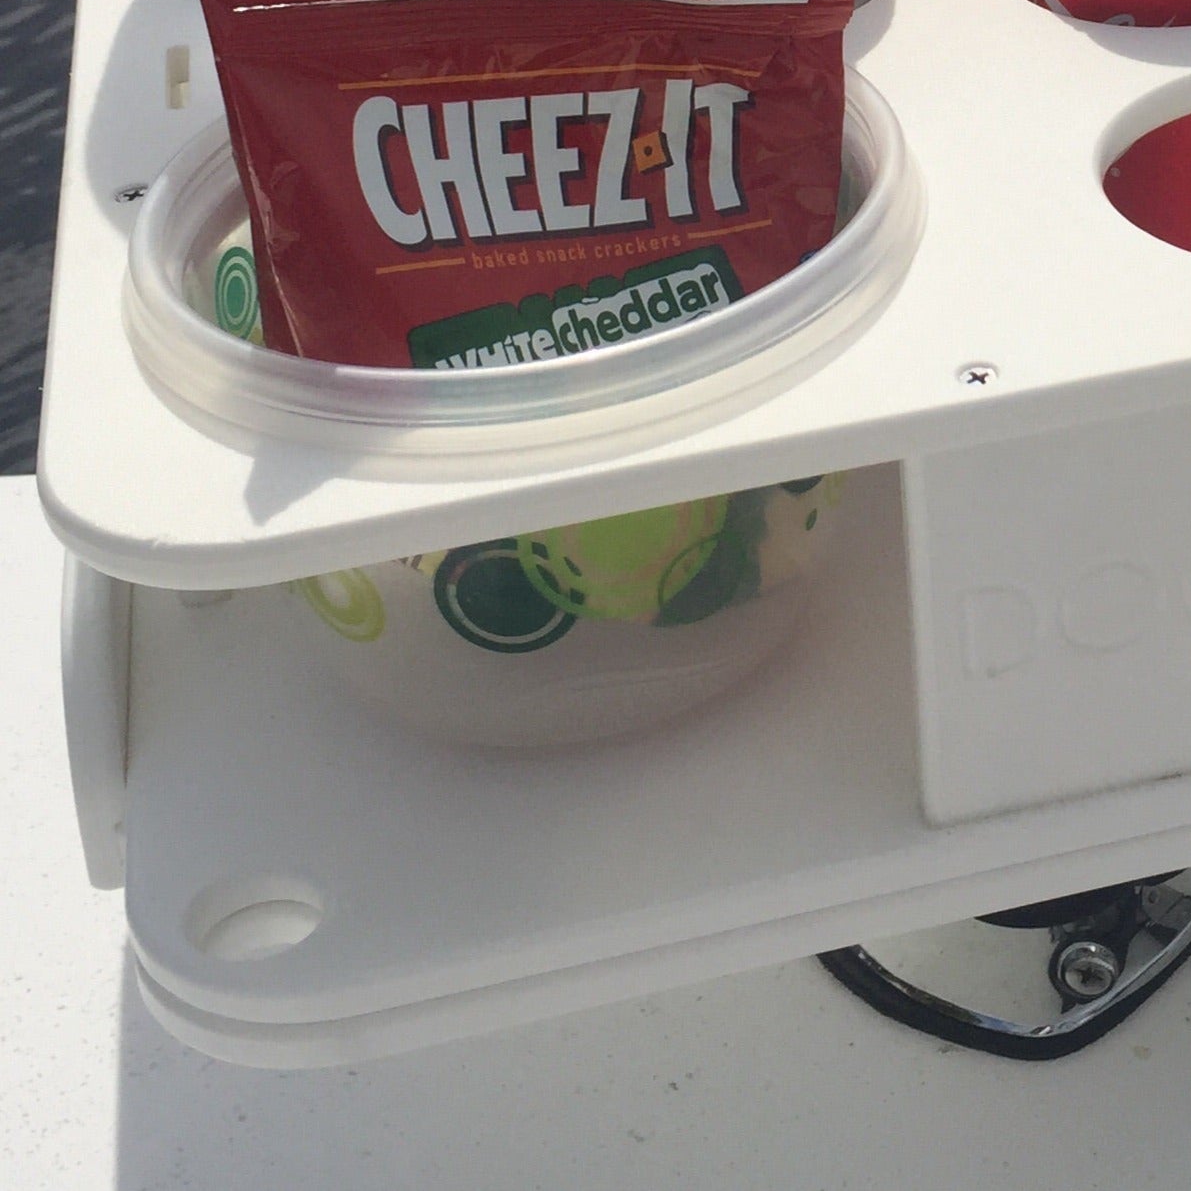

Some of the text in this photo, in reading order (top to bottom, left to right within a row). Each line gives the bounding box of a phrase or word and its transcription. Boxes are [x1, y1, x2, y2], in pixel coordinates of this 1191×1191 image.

[472, 233, 682, 270] baked snack crackers
